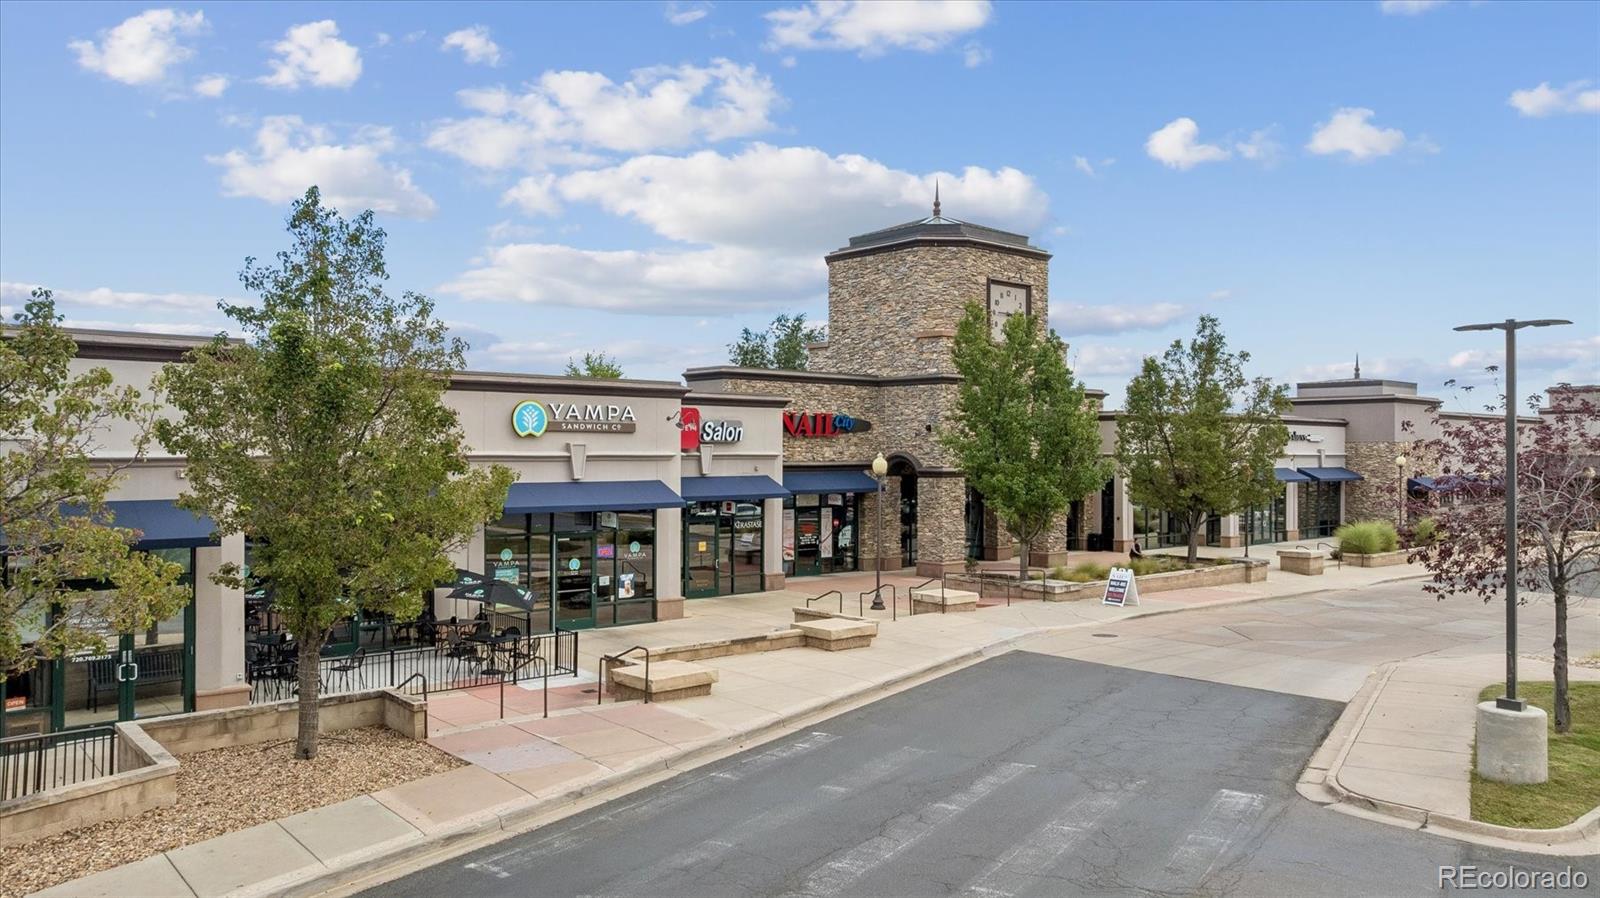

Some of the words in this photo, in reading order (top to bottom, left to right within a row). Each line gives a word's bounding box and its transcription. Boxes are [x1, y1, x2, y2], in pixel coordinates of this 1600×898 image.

[549, 403, 637, 421] YAMPA
[561, 422, 608, 430] SANDWICH
[703, 421, 744, 442] Salon
[783, 408, 840, 438] NAIL
